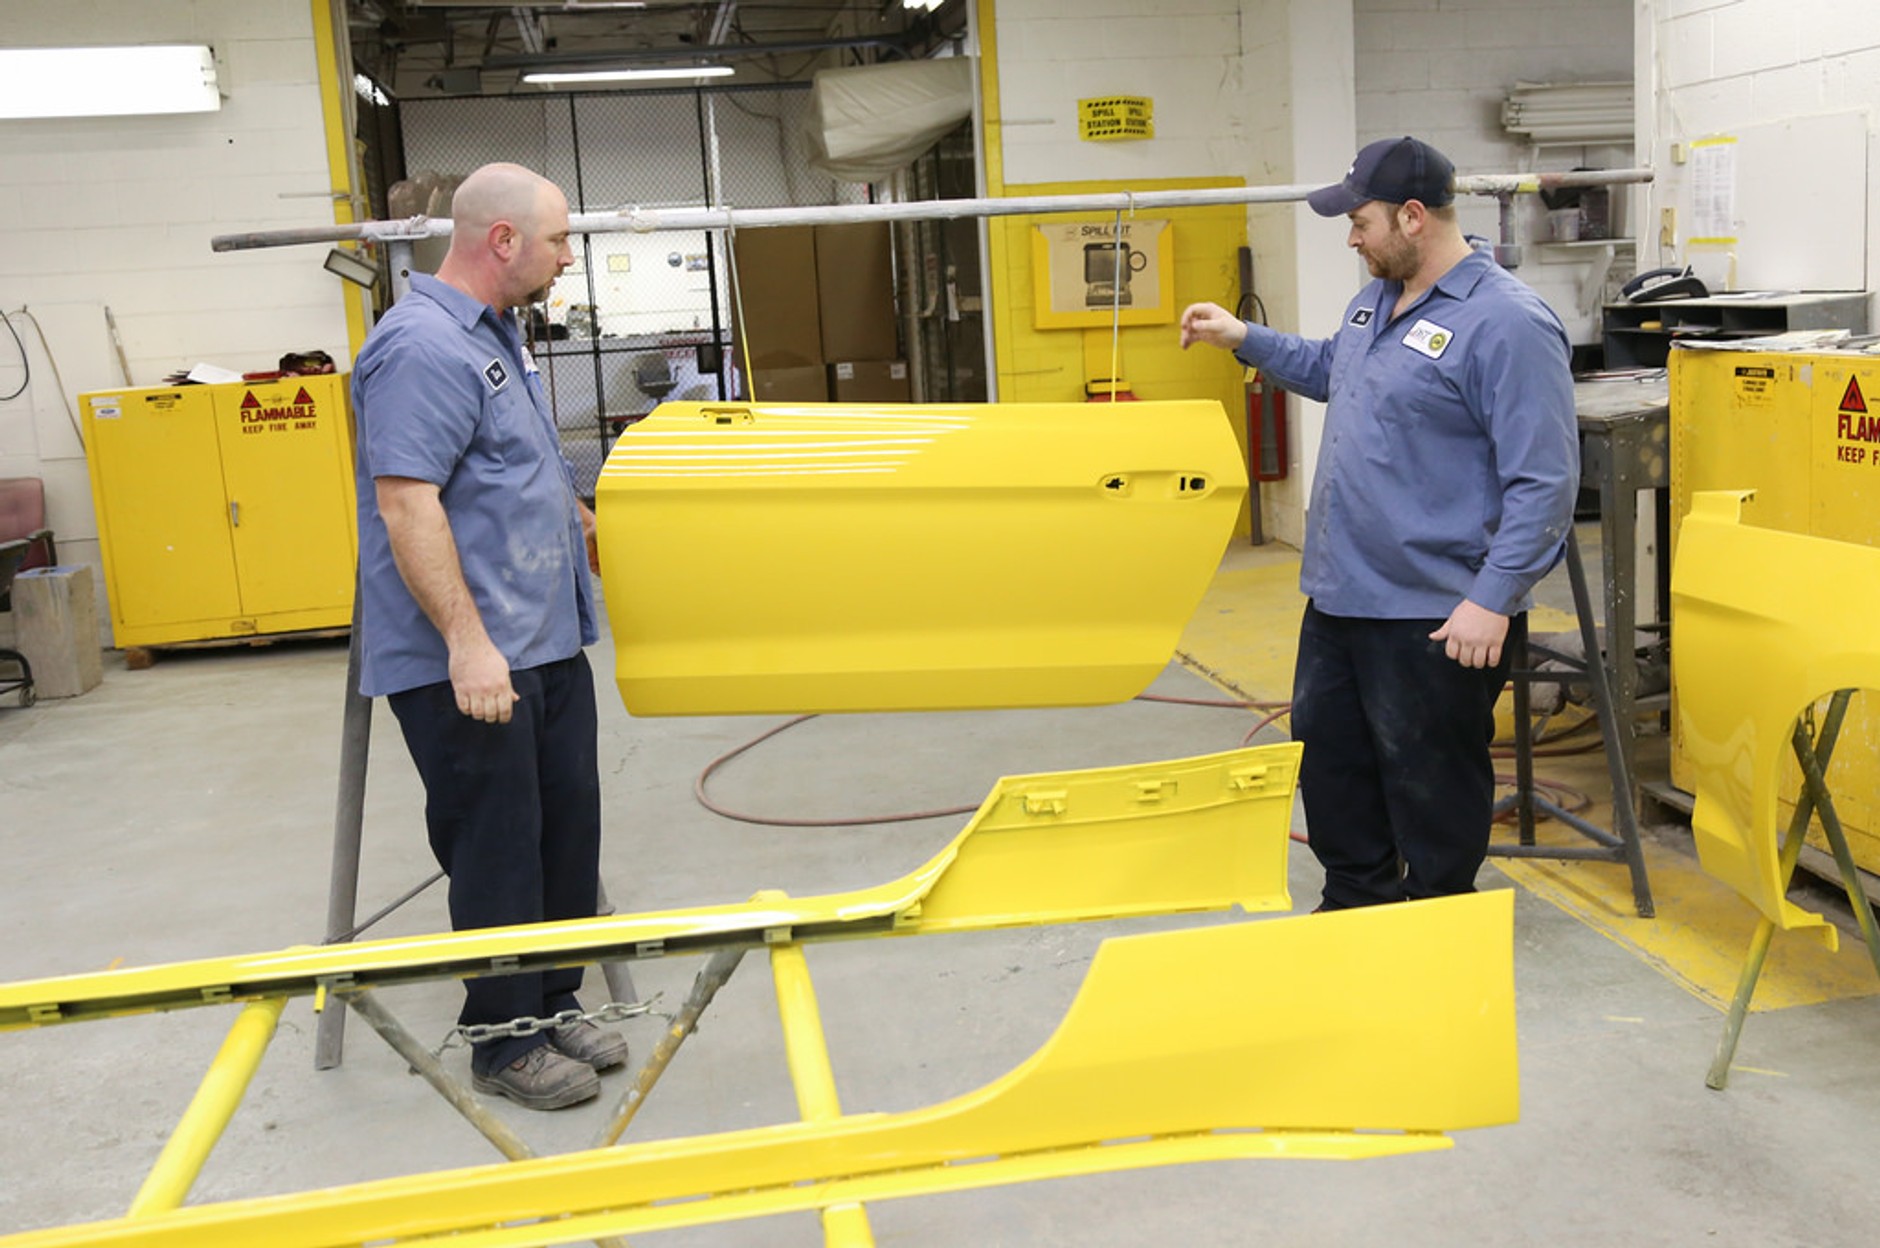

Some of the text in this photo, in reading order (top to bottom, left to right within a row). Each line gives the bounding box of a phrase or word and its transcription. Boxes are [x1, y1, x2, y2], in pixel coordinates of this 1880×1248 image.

[1092, 108, 1114, 118] SPILL
[1087, 119, 1121, 129] STATION
[1081, 225, 1109, 237] SPILL
[240, 405, 317, 423] FLAMMABLE
[242, 421, 316, 434] KEEP FIRE AWAY
[1837, 445, 1866, 464] KEEP
